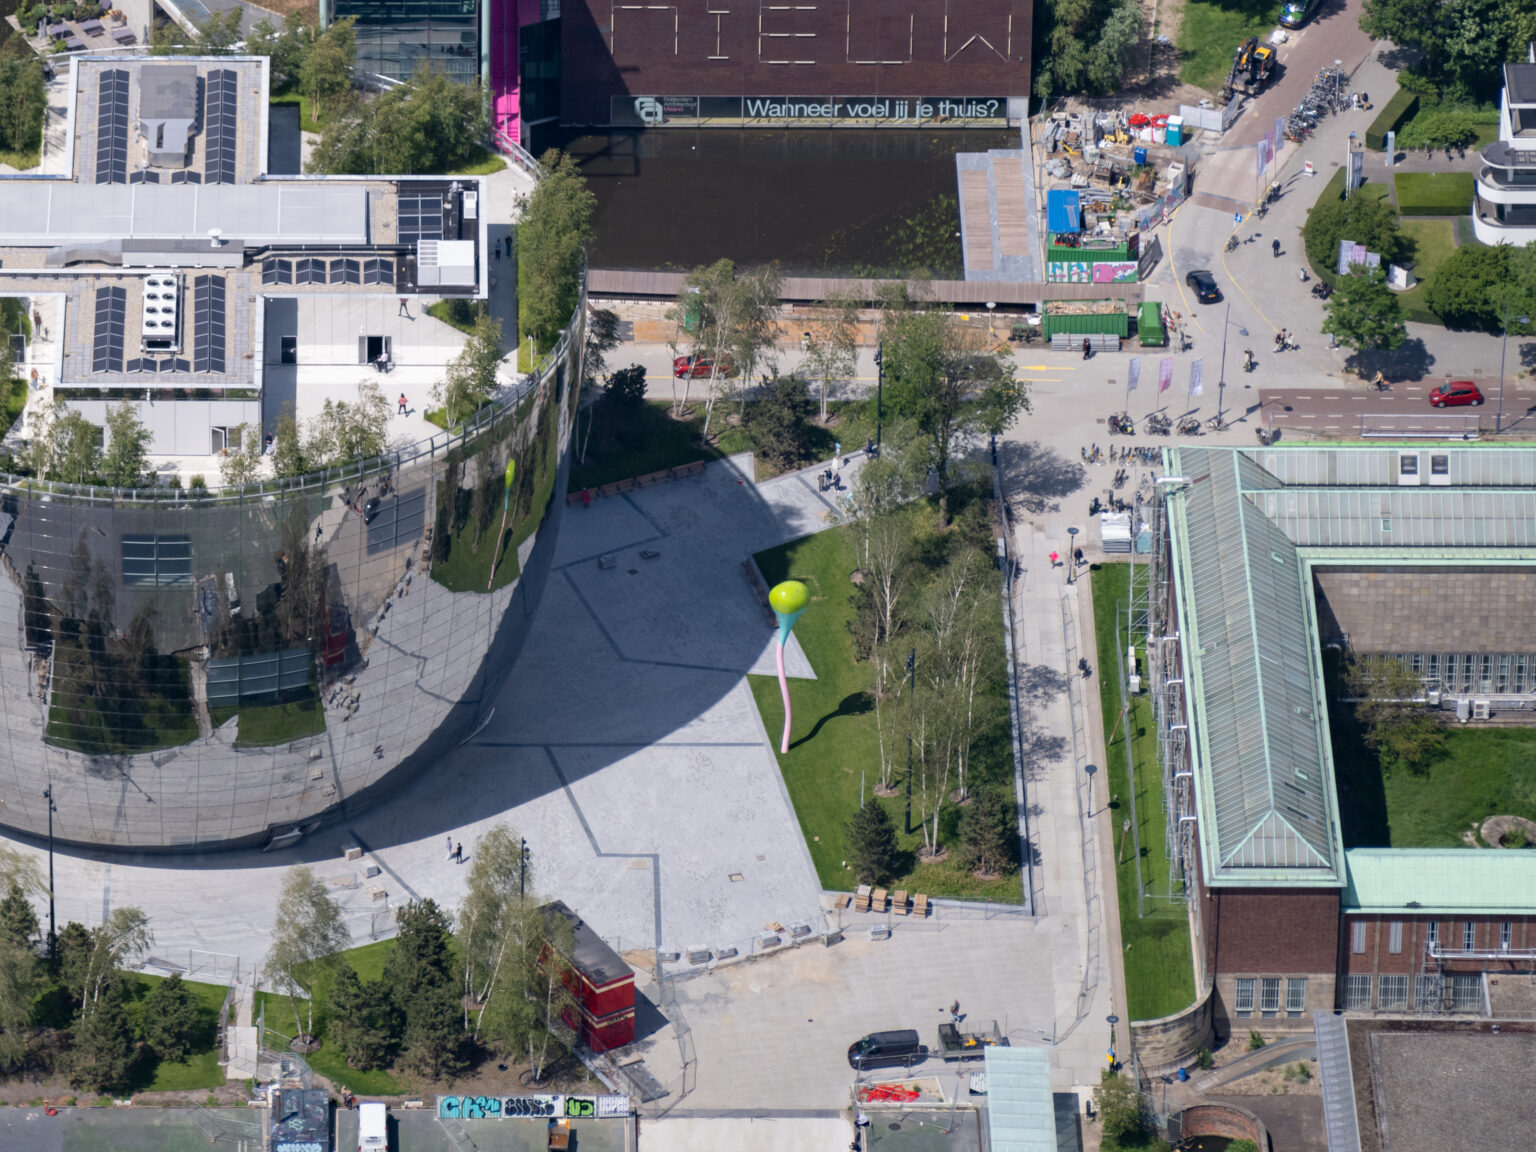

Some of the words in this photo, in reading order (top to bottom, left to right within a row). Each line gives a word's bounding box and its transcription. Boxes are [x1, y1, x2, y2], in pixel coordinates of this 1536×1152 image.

[747, 99, 843, 117] Wanneer
[846, 99, 890, 117] voel
[893, 100, 909, 120] jij
[913, 100, 934, 120] je
[937, 99, 999, 117] thuis?
